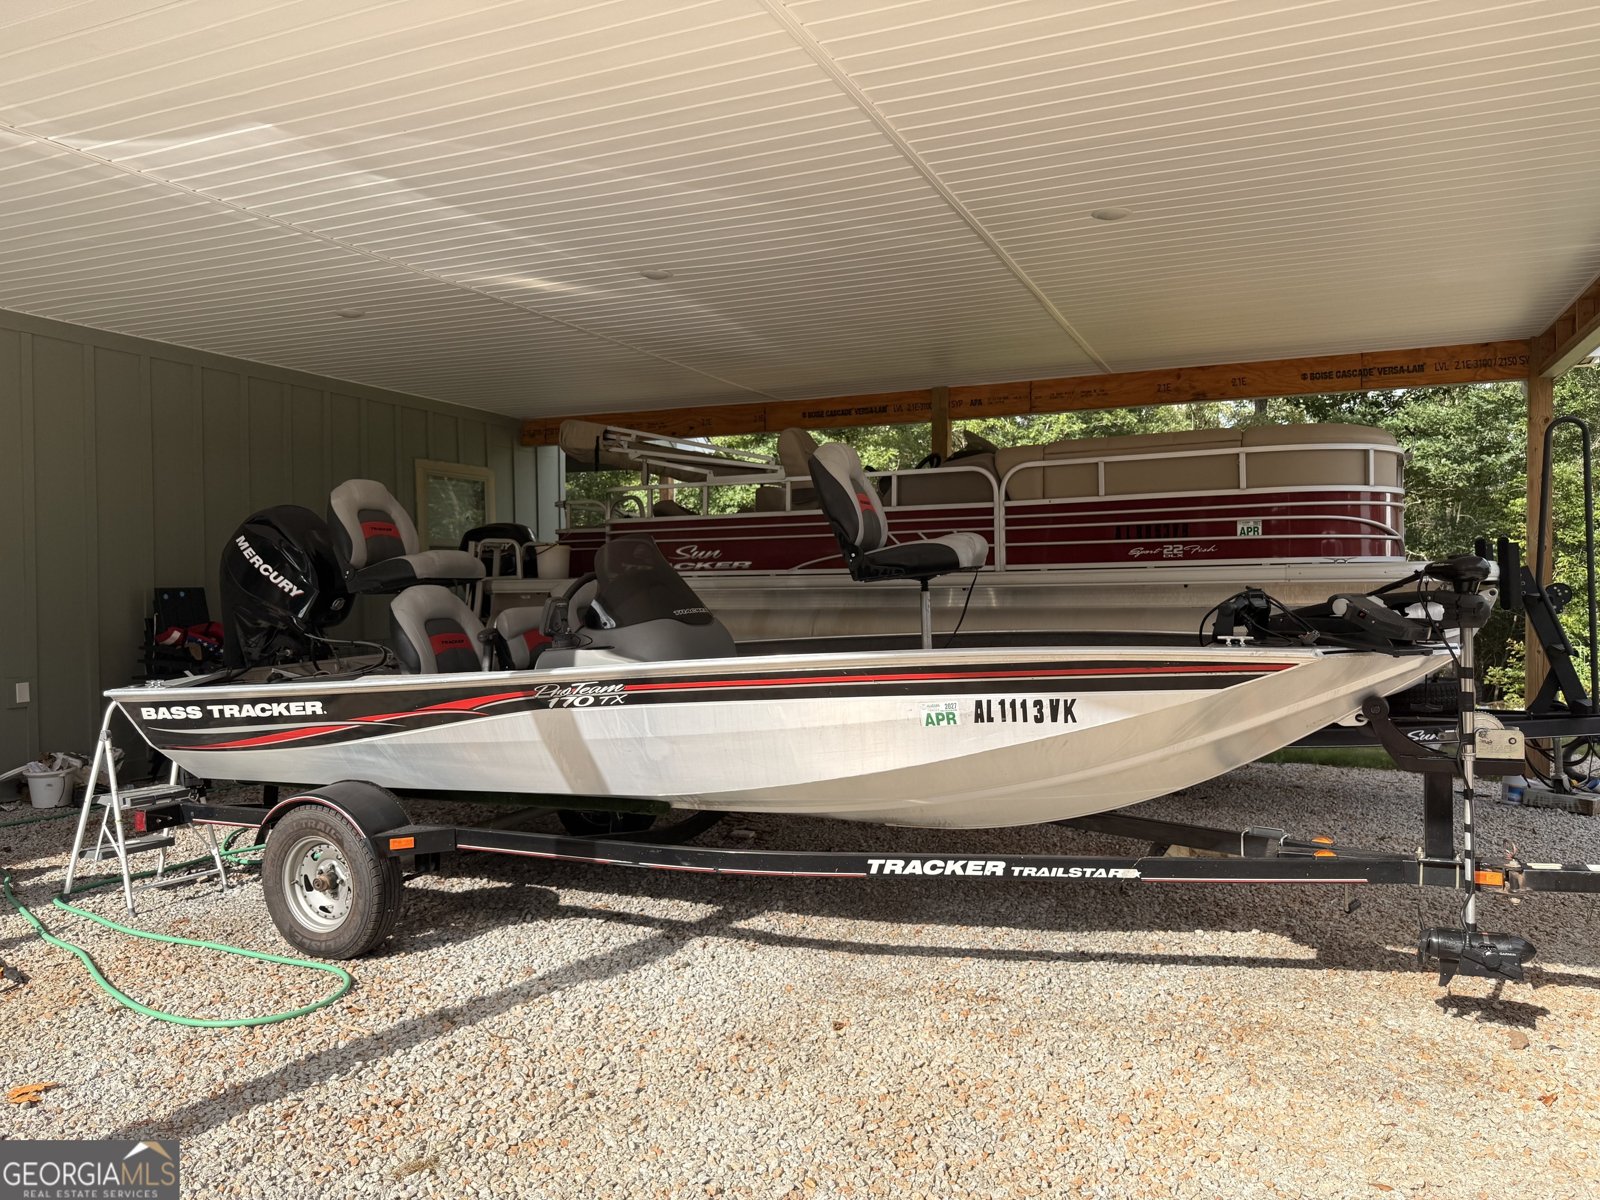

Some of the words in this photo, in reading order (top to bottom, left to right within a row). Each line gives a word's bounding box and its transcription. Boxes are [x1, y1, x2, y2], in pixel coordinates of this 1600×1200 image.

[1309, 371, 1334, 381] BOISE
[1335, 367, 1375, 379] CASCADE
[1434, 362, 1450, 372] LVL
[1239, 526, 1260, 536] APR
[668, 545, 723, 560] Sun
[1127, 547, 1162, 558] Sport
[1163, 544, 1184, 555] 22
[1184, 544, 1219, 555] Fish
[235, 535, 305, 597] MERCURY
[548, 695, 595, 709] 170
[599, 694, 629, 705] TX
[140, 705, 203, 720] BASS
[206, 701, 325, 719] TRACKER
[925, 711, 957, 727] APR
[867, 859, 1006, 876] TRACKER
[1011, 866, 1122, 879] TRAILSTAR
